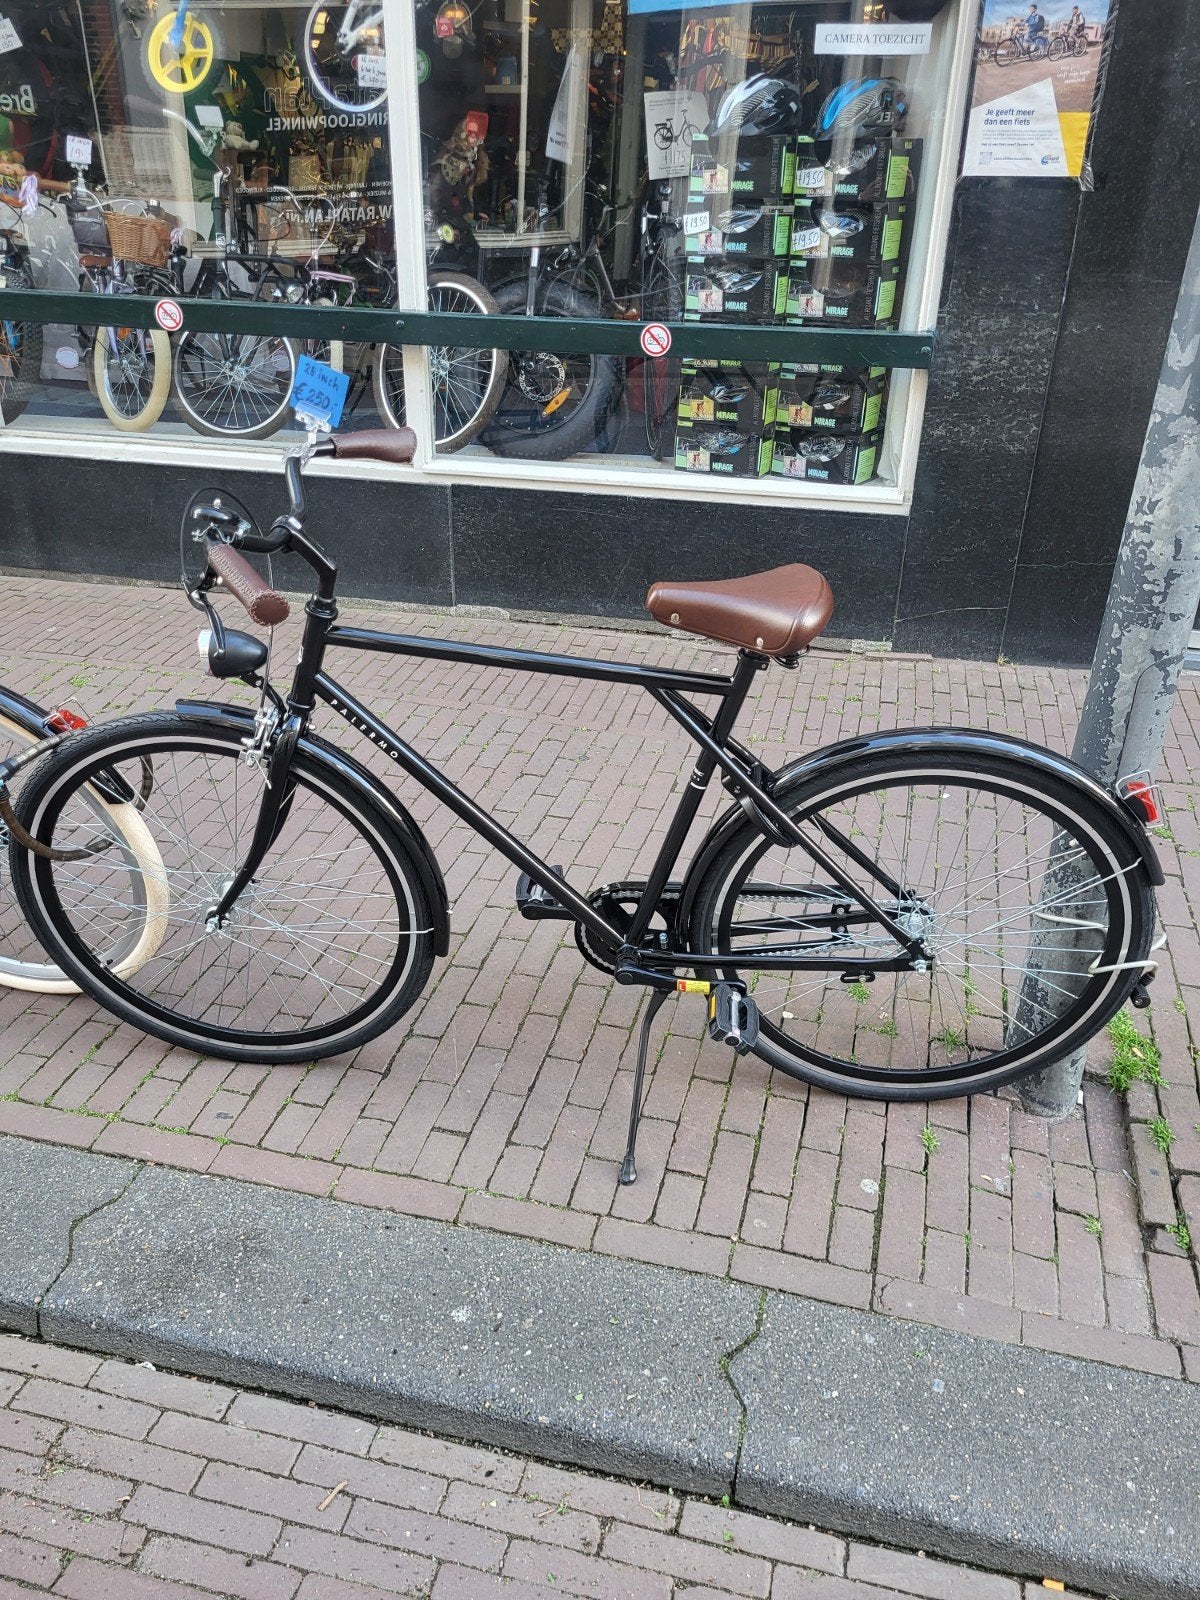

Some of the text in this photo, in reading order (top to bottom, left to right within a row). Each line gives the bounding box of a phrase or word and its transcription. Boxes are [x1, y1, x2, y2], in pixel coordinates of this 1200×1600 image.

[824, 33, 926, 45] CAMERA TOEZICHT
[985, 108, 995, 116] Je
[995, 108, 1015, 117] geeft
[1014, 118, 1031, 126] fiets
[730, 181, 754, 190] MIRAGE
[835, 183, 858, 194] MIRAGE
[725, 242, 748, 252] MIRAGE
[830, 246, 854, 256] MIRAGE
[725, 301, 748, 310] MIRAGE
[826, 306, 848, 316] MIRAGE
[304, 362, 316, 377] 28
[716, 411, 738, 420] MIRAGE
[814, 417, 836, 427] MIRAGE
[712, 462, 733, 472] MIRAGE
[807, 468, 829, 478] MIRAGE
[331, 699, 398, 758] PALERMO
